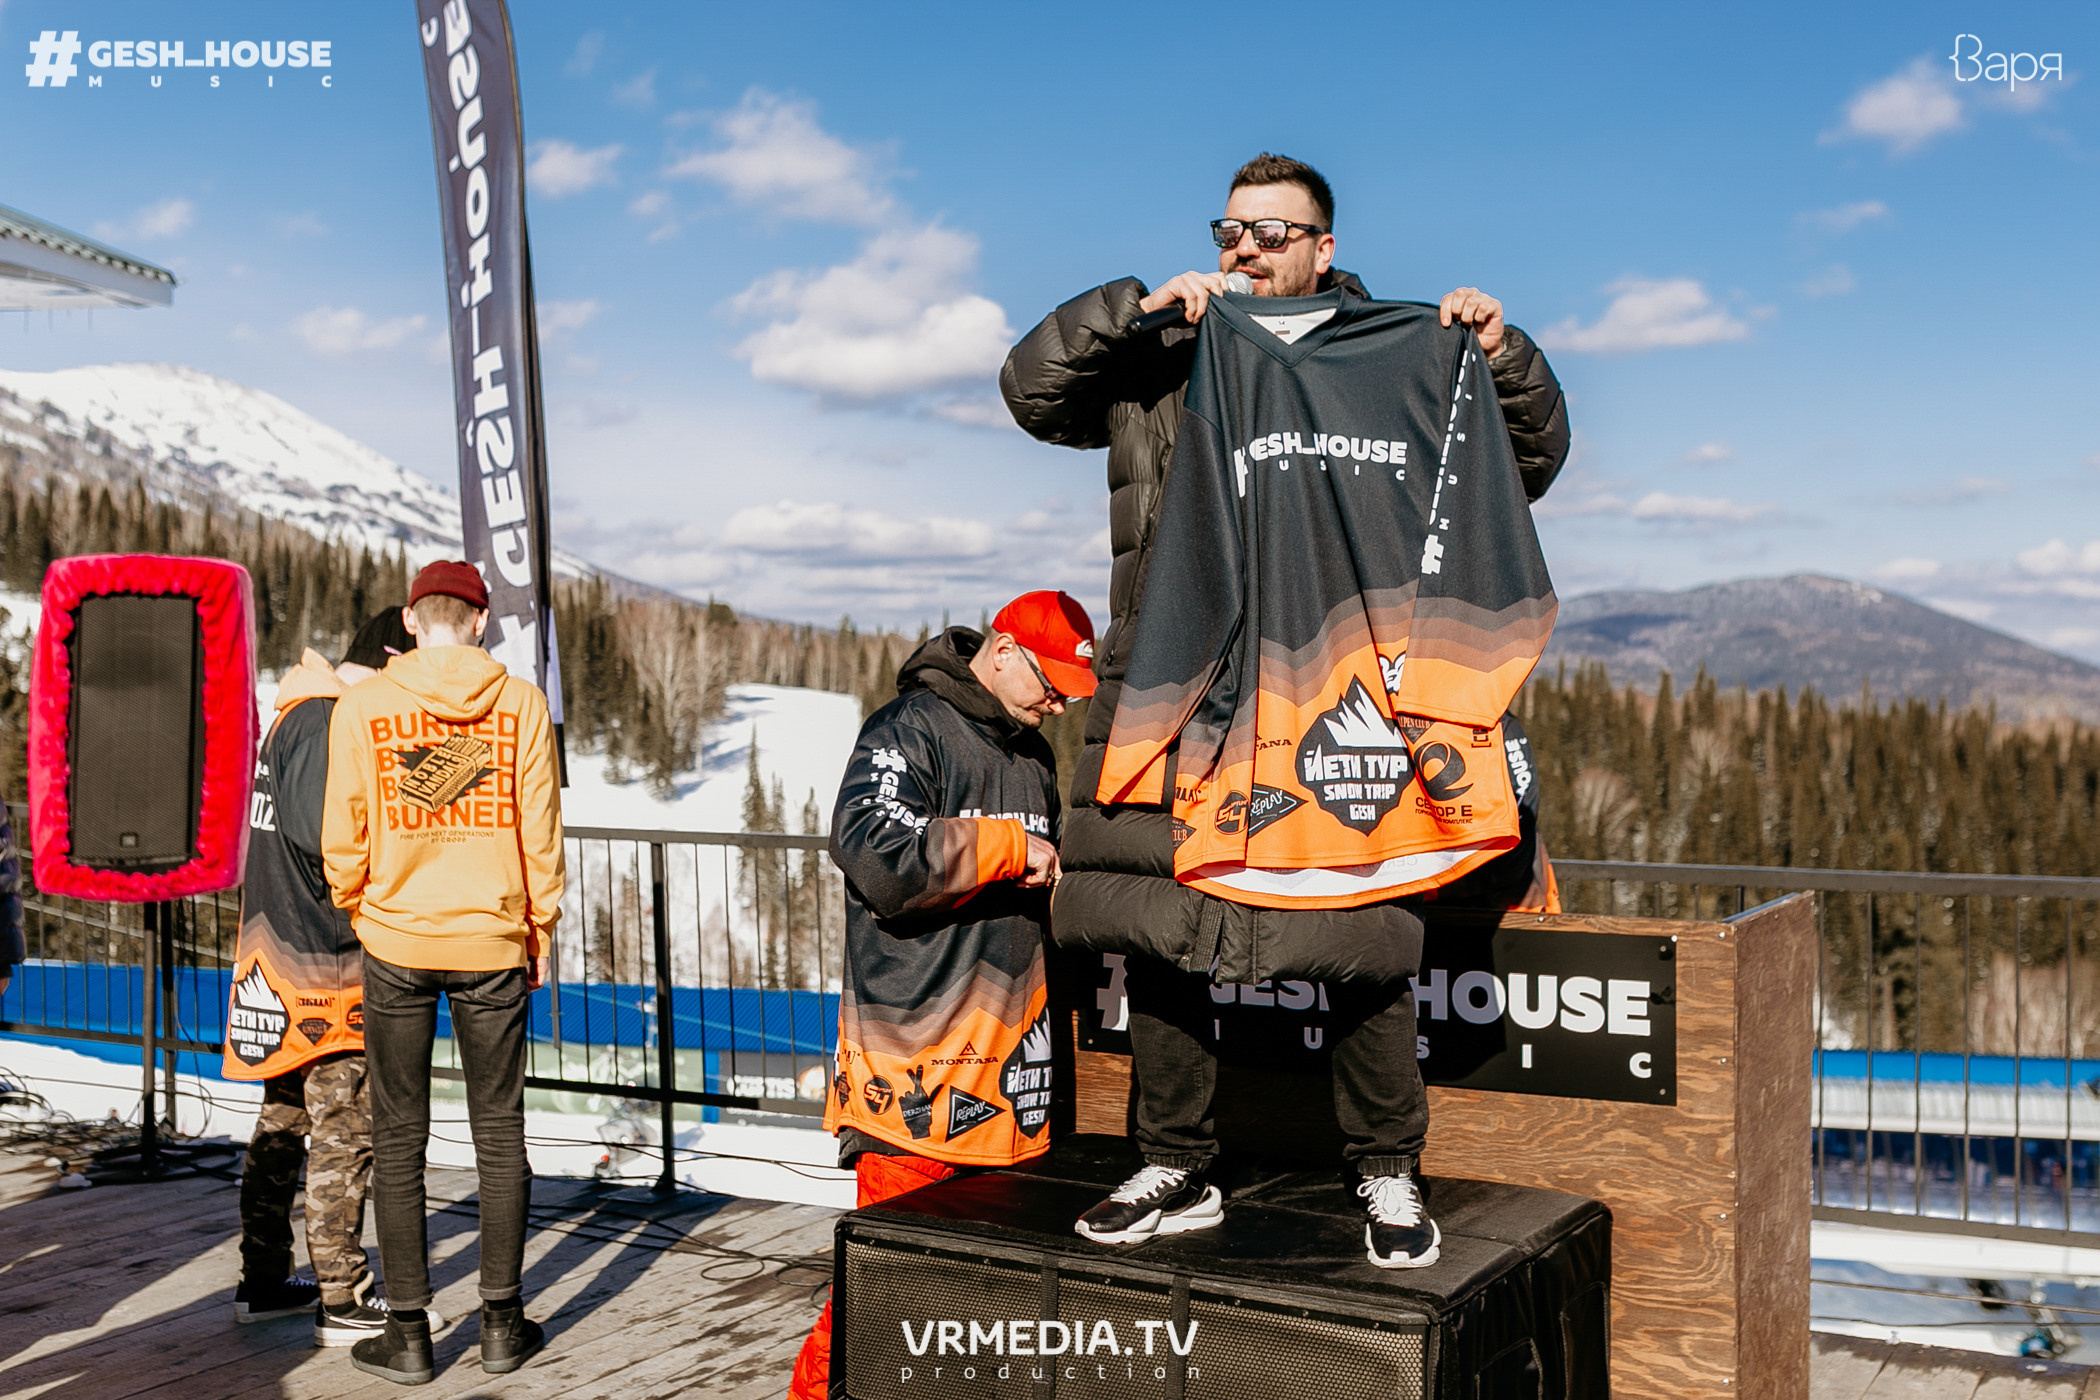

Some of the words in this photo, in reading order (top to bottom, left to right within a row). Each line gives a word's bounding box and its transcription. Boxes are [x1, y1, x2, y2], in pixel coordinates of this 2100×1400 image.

[1278, 459, 1406, 481] USIC
[403, 750, 452, 789] NOBLE
[417, 755, 469, 795] VANDALS
[1323, 783, 1363, 801] SNOW
[1364, 783, 1396, 800] TRIP
[386, 801, 516, 831] BURNED
[1349, 804, 1376, 821] GESH
[416, 832, 430, 840] FOR
[430, 830, 447, 838] NEXT
[448, 830, 495, 838] GENERATIONS
[257, 1030, 281, 1046] TRIP
[239, 1043, 265, 1059] GESH
[931, 1056, 999, 1066] MONTANA
[956, 1101, 986, 1121] REPLAY
[1022, 1109, 1046, 1127] GESH
